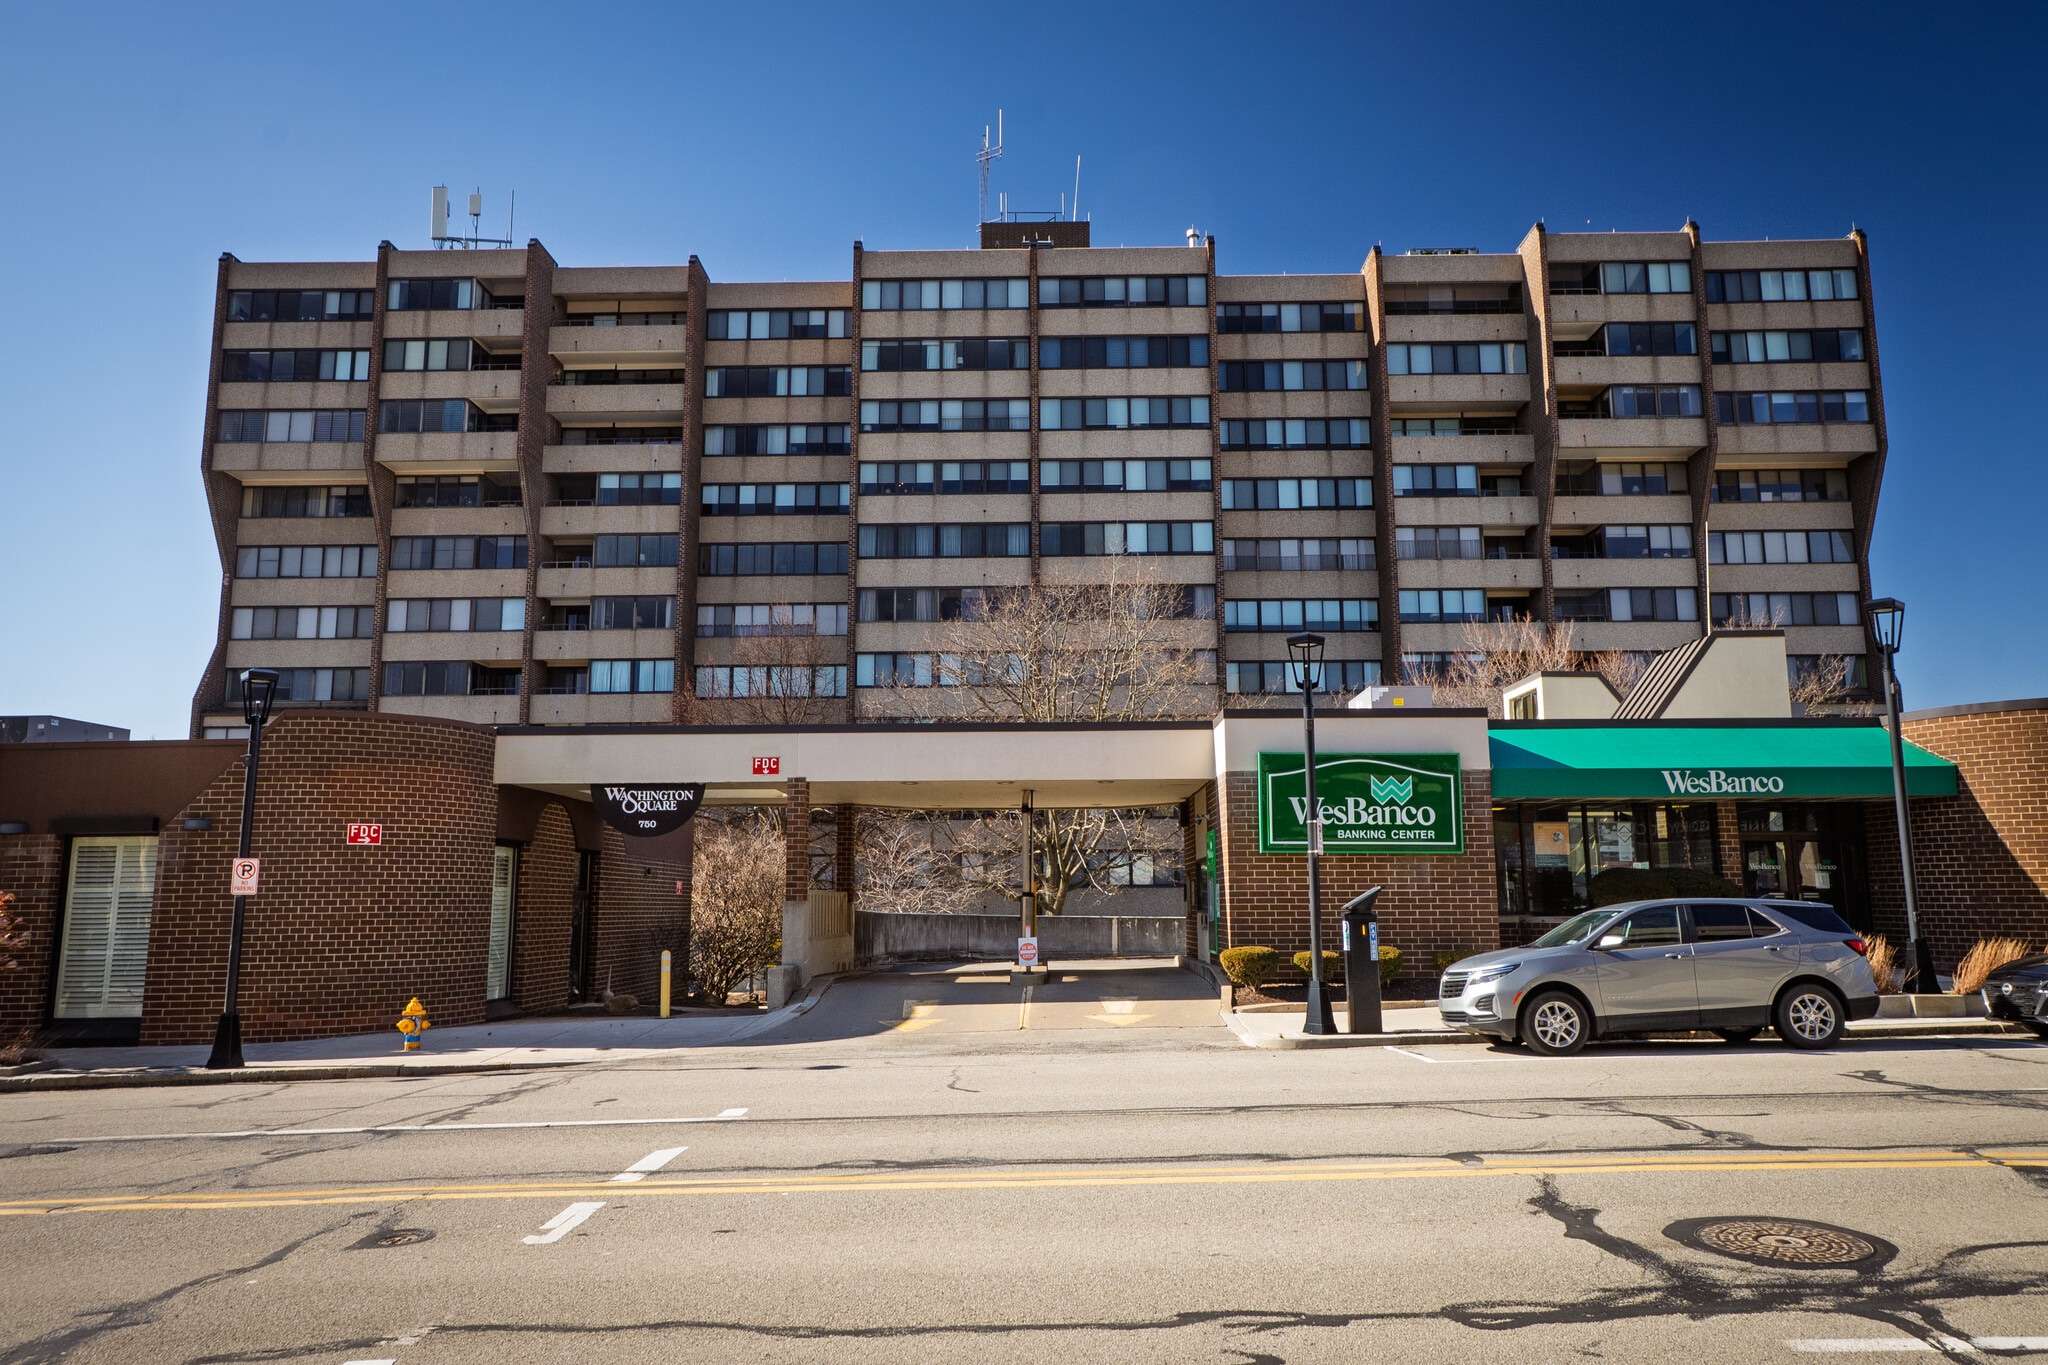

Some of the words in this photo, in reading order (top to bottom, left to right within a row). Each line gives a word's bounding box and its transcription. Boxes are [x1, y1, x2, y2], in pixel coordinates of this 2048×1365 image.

[754, 758, 777, 769] FDC
[1661, 770, 1784, 794] WesBanco
[622, 793, 678, 813] SQUARE
[1288, 797, 1436, 826] WesBanco
[638, 820, 657, 829] 750
[350, 825, 379, 837] FDC
[1337, 829, 1387, 839] BANKING
[1391, 829, 1436, 839] CENTER
